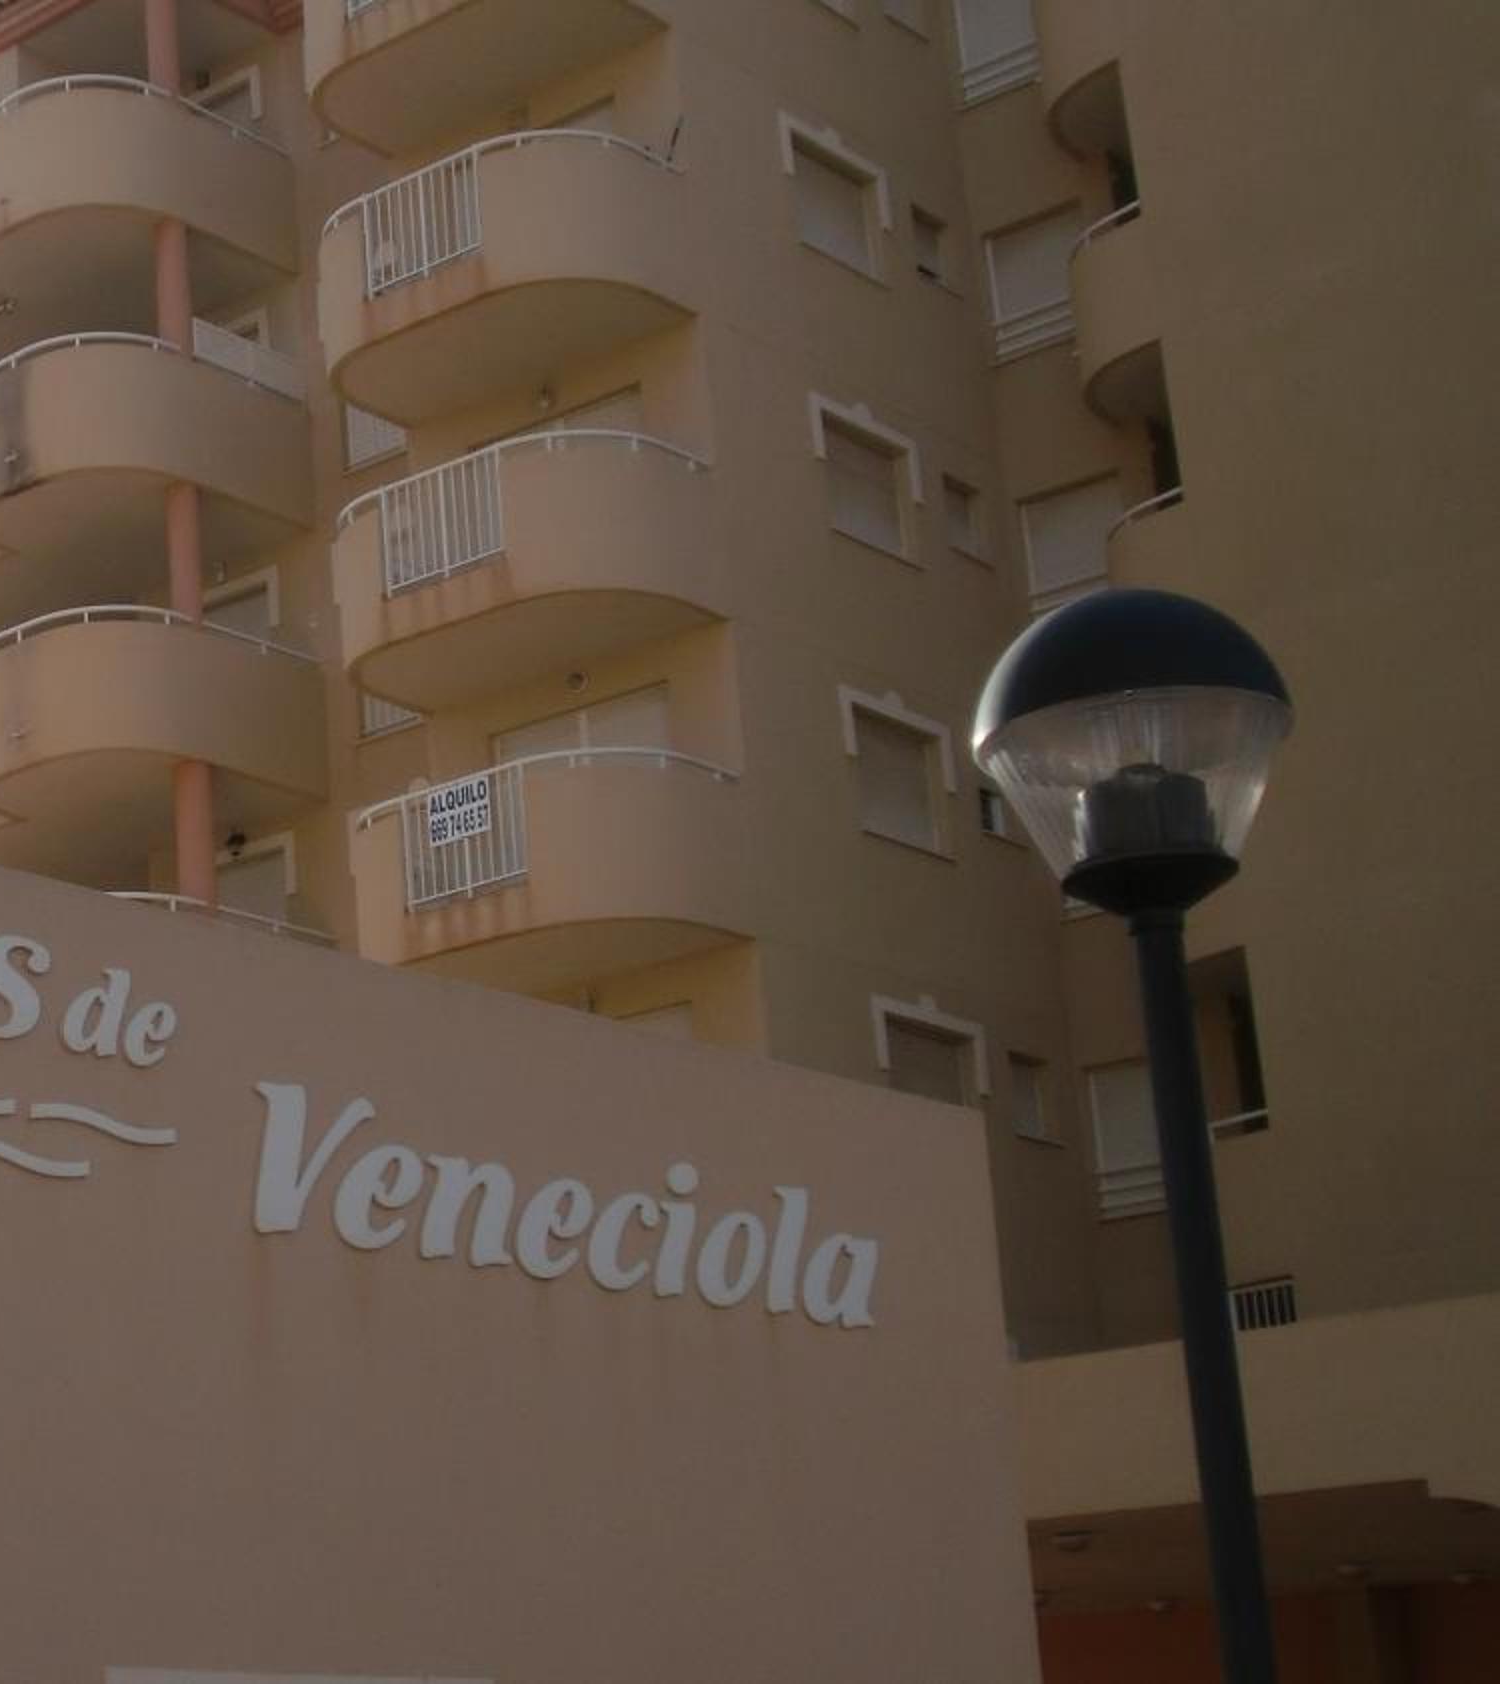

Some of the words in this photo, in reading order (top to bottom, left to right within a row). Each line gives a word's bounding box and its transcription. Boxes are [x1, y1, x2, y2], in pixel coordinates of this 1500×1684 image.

[430, 780, 487, 817] ALQUILO
[61, 968, 178, 1067] de
[254, 1081, 880, 1329] Veneciola
